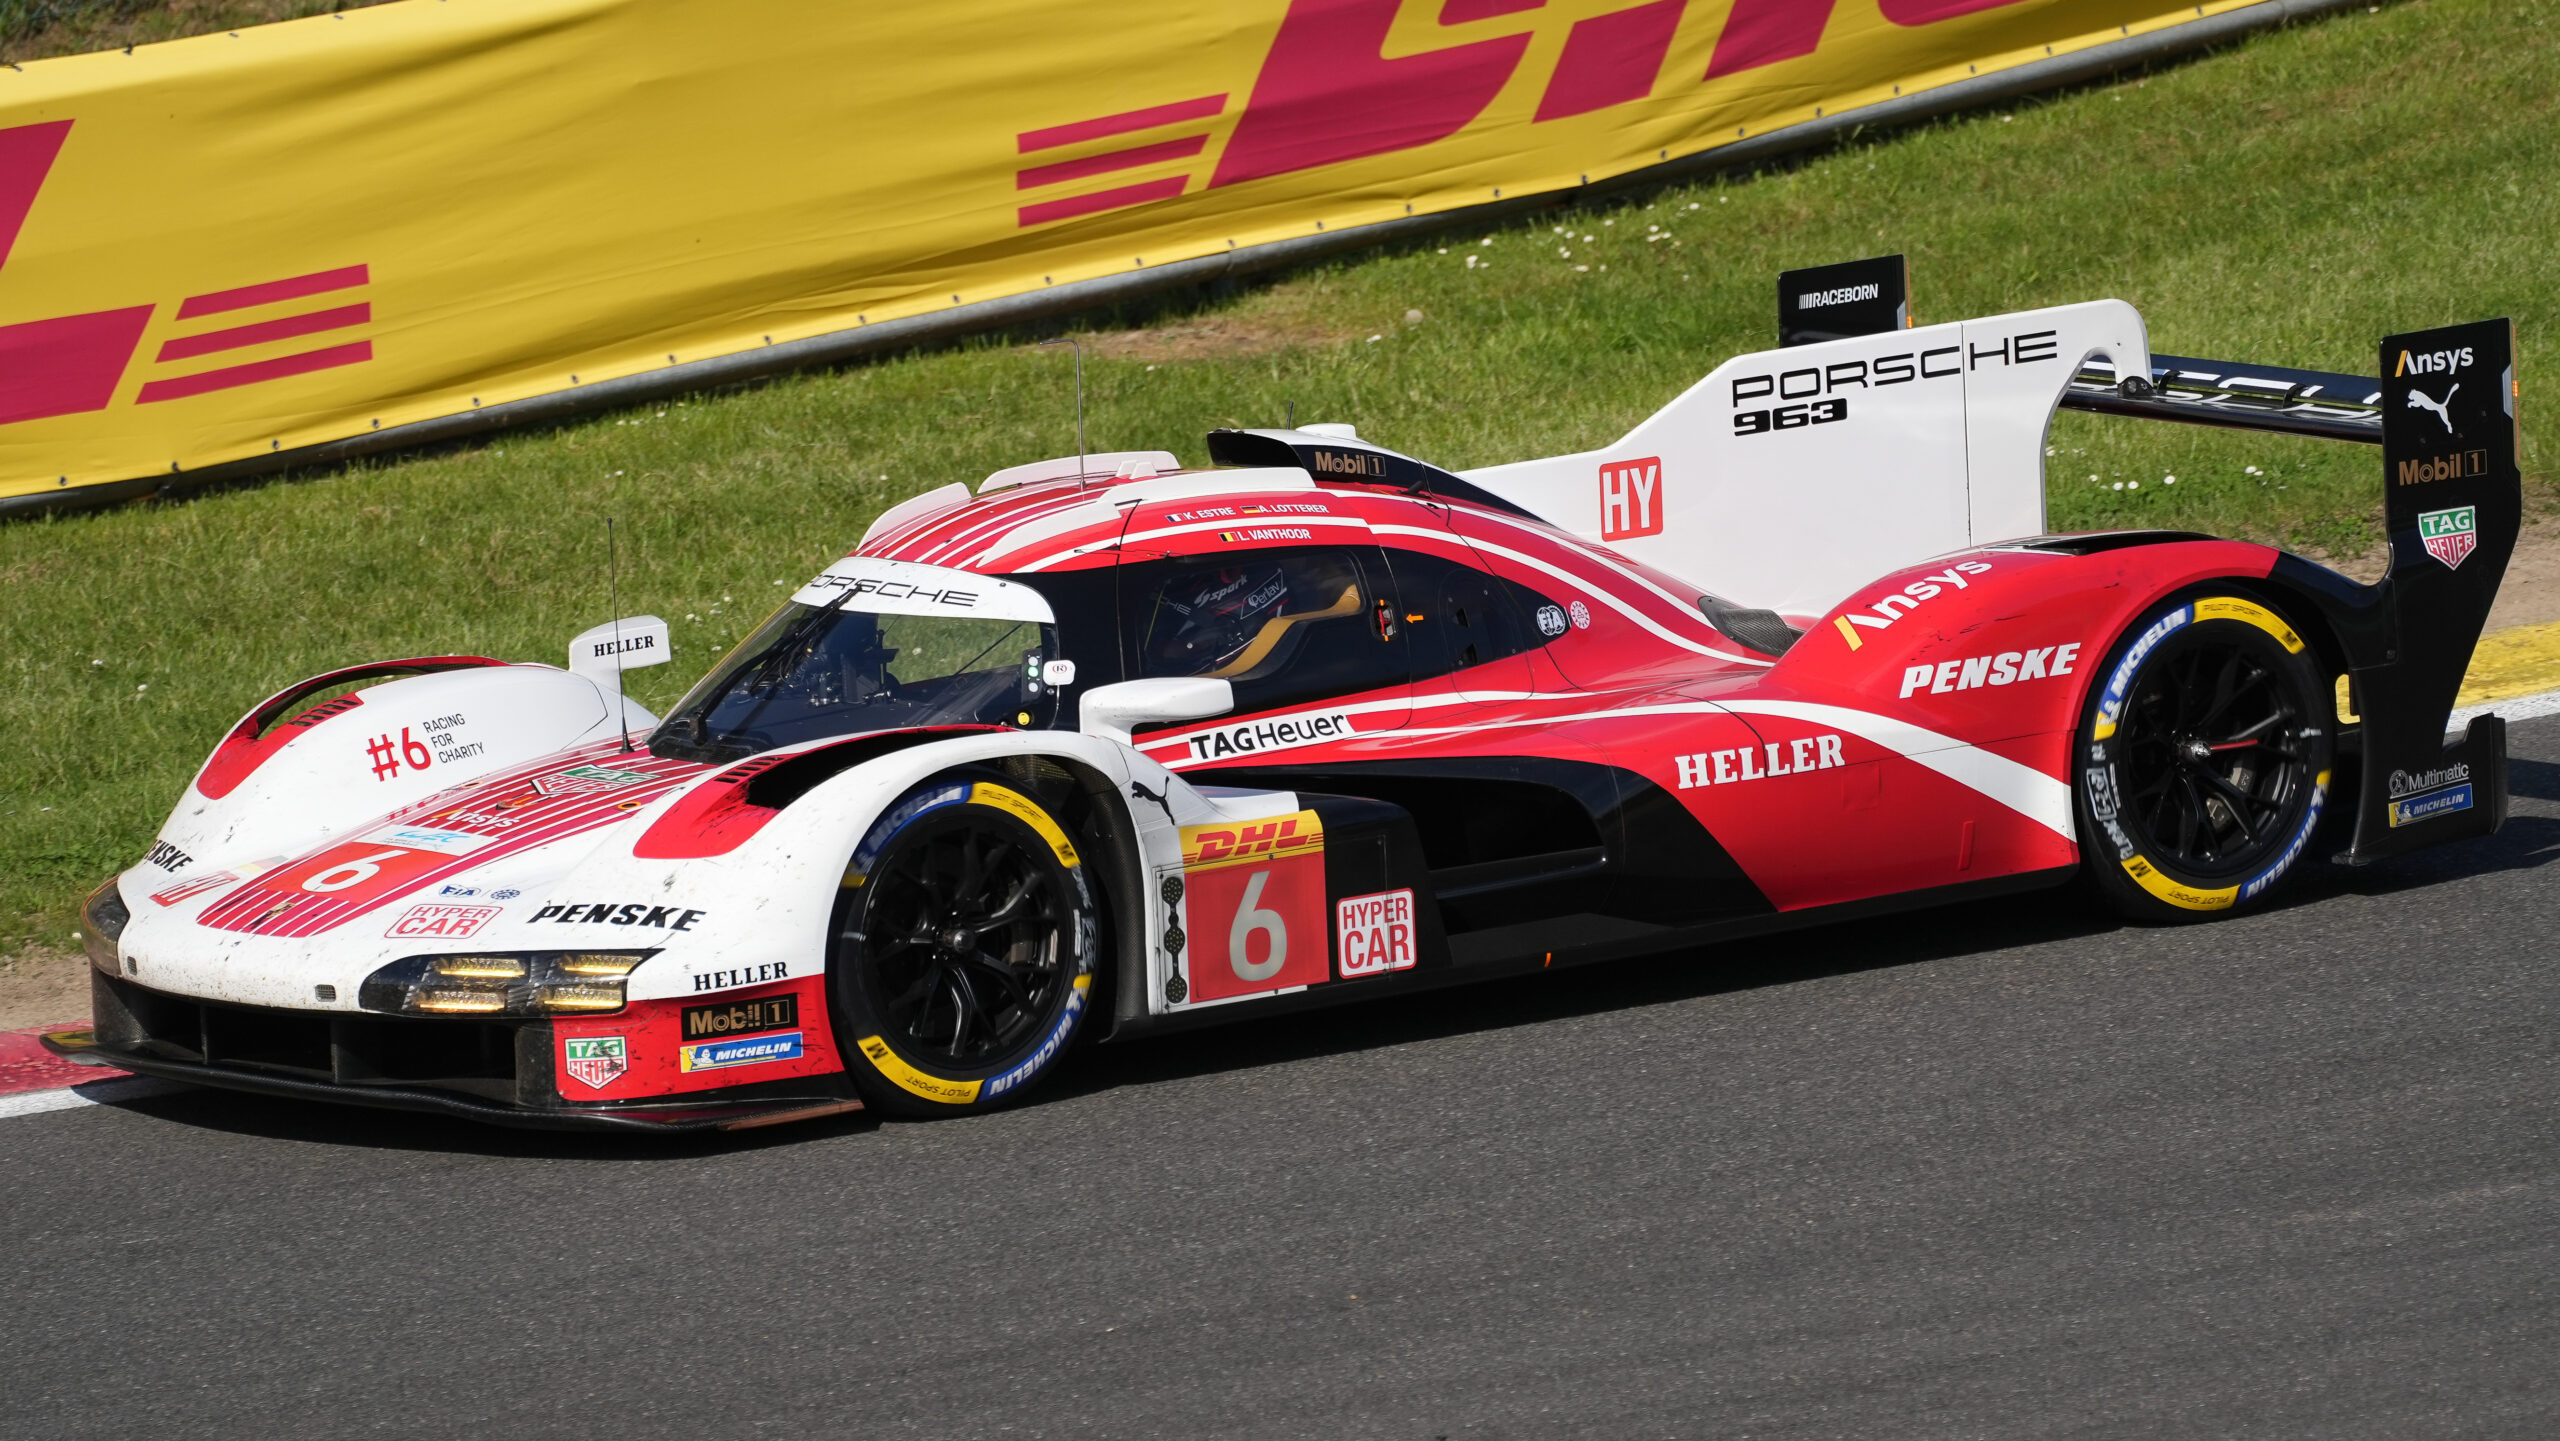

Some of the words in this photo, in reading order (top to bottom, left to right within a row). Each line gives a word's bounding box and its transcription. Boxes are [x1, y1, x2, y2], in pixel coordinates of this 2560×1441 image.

[1812, 283, 1879, 308] RACEBORN
[1732, 330, 2057, 407] PORSCHE
[2395, 347, 2474, 377] Ansys
[1733, 398, 1848, 437] 963
[1315, 451, 1366, 475] Mobil
[2399, 453, 2461, 486] Mobil
[1273, 505, 1330, 514] LOTTERER
[1602, 464, 1657, 534] HY
[1185, 511, 1198, 520] K.
[1200, 507, 1236, 518] ESTRE
[2423, 511, 2472, 534] TAG
[1250, 529, 1312, 541] VANTHOOR
[2427, 532, 2474, 566] HEUER
[1538, 610, 1564, 630] FIA
[1833, 560, 1993, 652] Ansys
[593, 634, 656, 658] HELLER
[2110, 607, 2187, 698] MICHELIN
[1899, 642, 2082, 700] PENSKE
[423, 713, 466, 734] RACING
[366, 726, 432, 783] #6
[431, 732, 455, 749] FOR
[438, 741, 485, 765] CHARITY
[1674, 734, 1846, 790] HELLER
[2408, 763, 2469, 791] Multimatic
[2413, 793, 2464, 815] MICHELIN
[431, 808, 521, 829] Ansys
[1195, 820, 1309, 862] DHL
[2245, 810, 2318, 898] MICHELIN
[145, 839, 194, 873] ENSKE
[302, 849, 411, 892] 6
[442, 885, 475, 897] FIA
[408, 905, 495, 919] HYPER
[527, 903, 706, 931] PENSKE
[1229, 870, 1288, 982] 6
[1343, 897, 1409, 930] HYPER
[396, 917, 480, 936] CAR
[1345, 922, 1411, 970] CAR
[693, 961, 788, 991] HELLER
[690, 1003, 760, 1035] Mobil
[570, 1041, 620, 1058] TAG
[715, 1042, 792, 1061] MICHELIN
[990, 1014, 1073, 1096] MICHELIN
[905, 1077, 938, 1096] SPORT
[940, 1089, 971, 1098] PILOT
